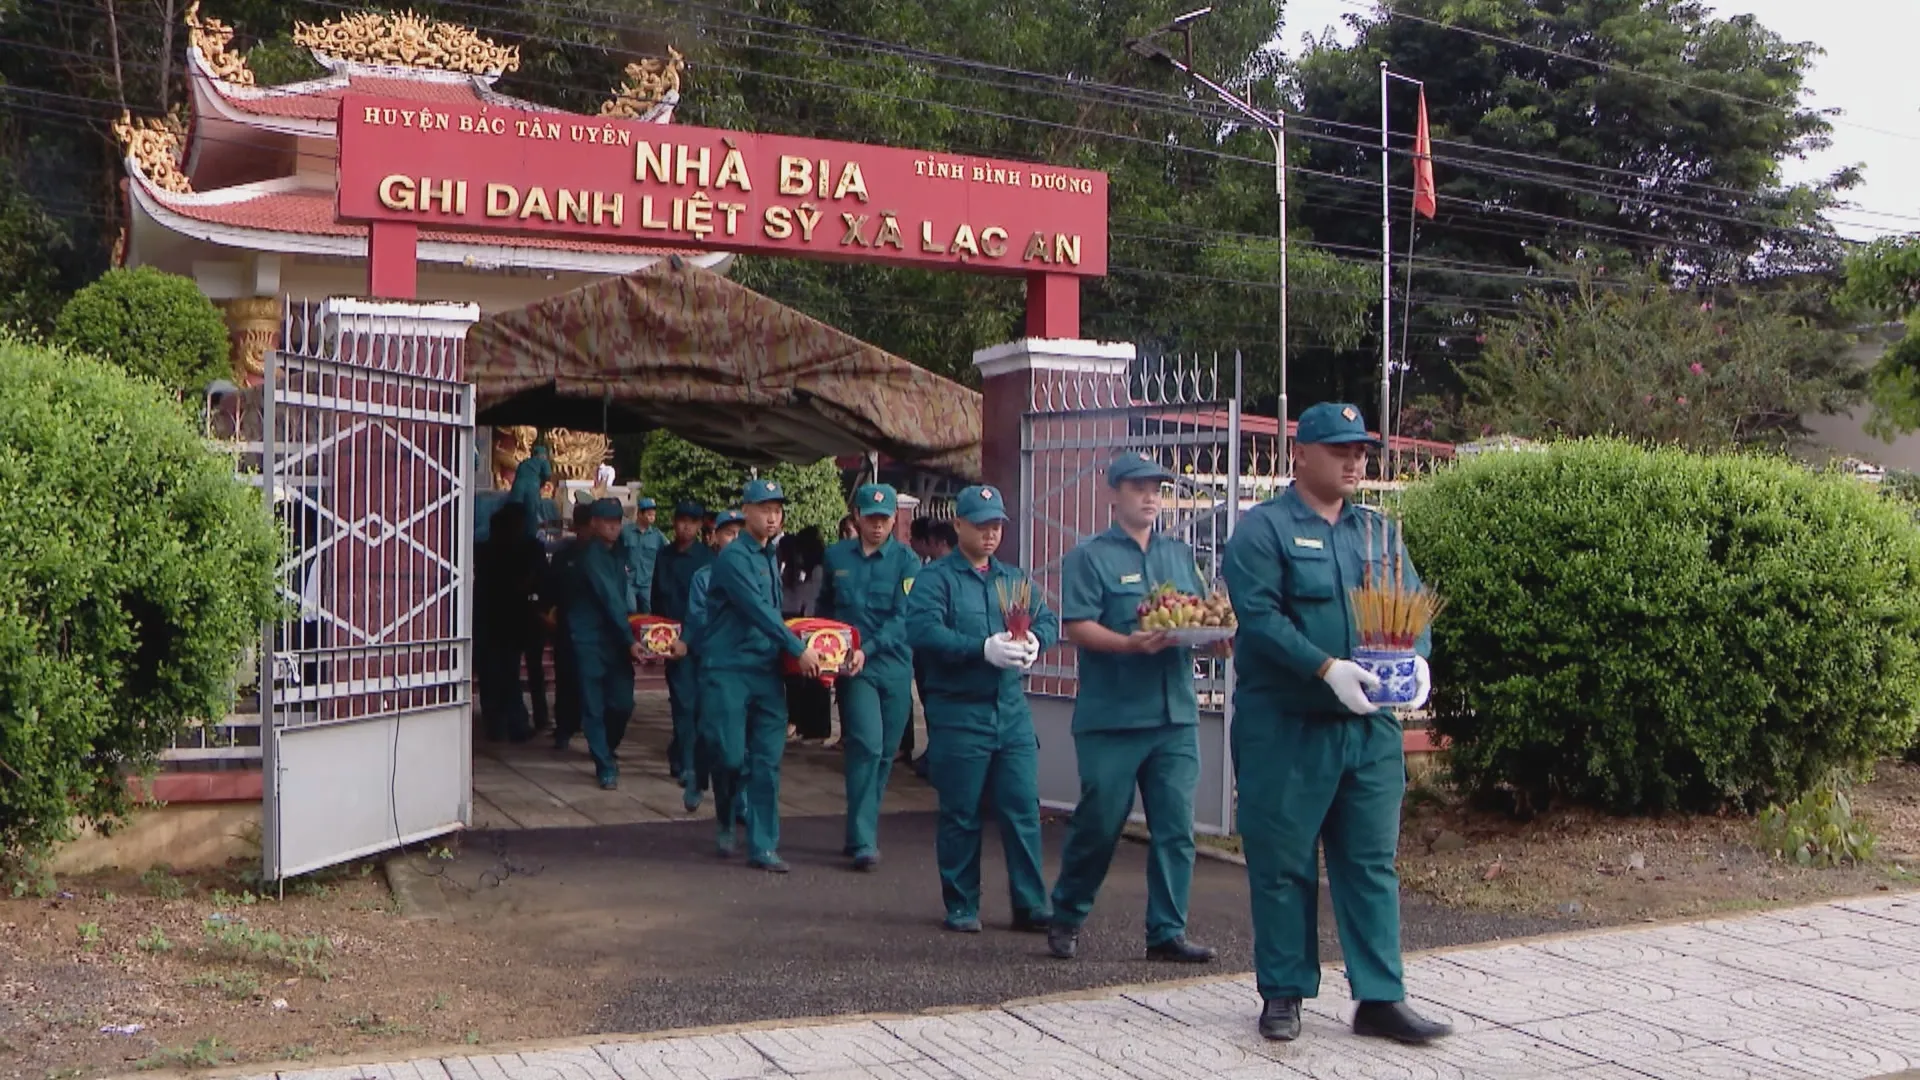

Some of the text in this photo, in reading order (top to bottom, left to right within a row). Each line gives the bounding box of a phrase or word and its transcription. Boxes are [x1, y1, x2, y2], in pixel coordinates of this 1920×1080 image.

[364, 106, 631, 146] HUYỆN BẮC TÂN UYÊN
[635, 137, 869, 203] NHÀ BIA
[914, 155, 1093, 195] TỈNH BÌNH DƯƠNG
[379, 174, 1082, 266] GHI DANH LIỆT SỸ XÃ LẠC AN
